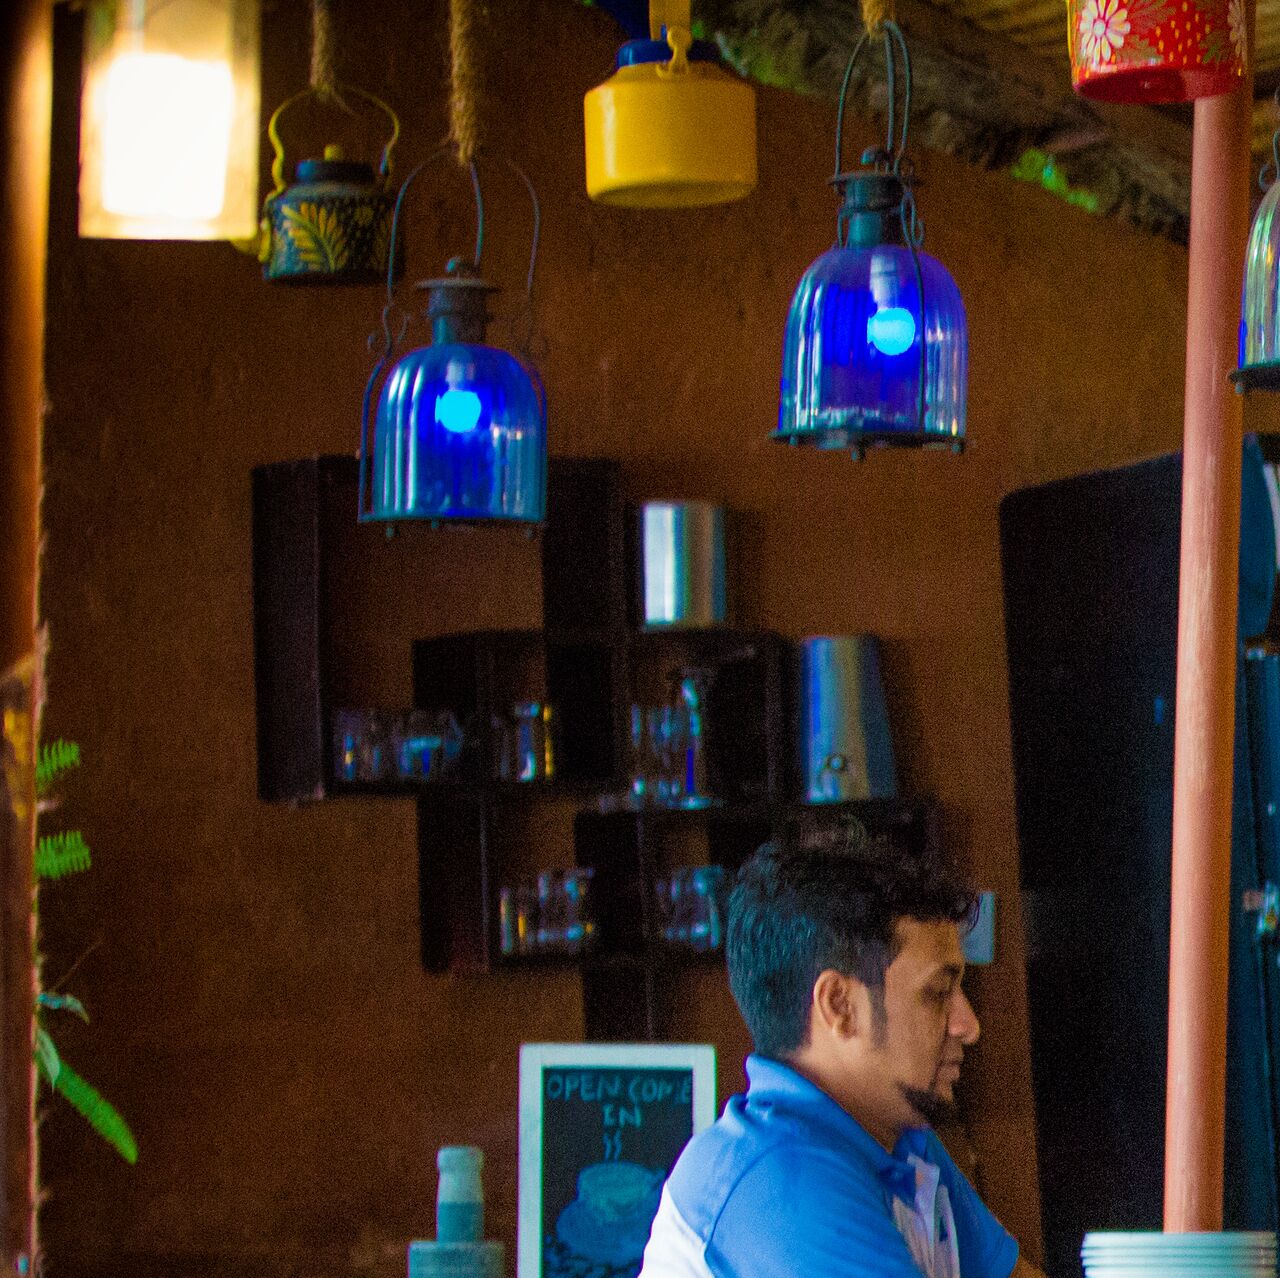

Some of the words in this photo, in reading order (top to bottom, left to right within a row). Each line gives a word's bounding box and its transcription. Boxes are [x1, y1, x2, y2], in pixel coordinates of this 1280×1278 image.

[548, 1072, 620, 1101] OPEN
[628, 1074, 691, 1104] COME
[602, 1103, 642, 1128] IN
